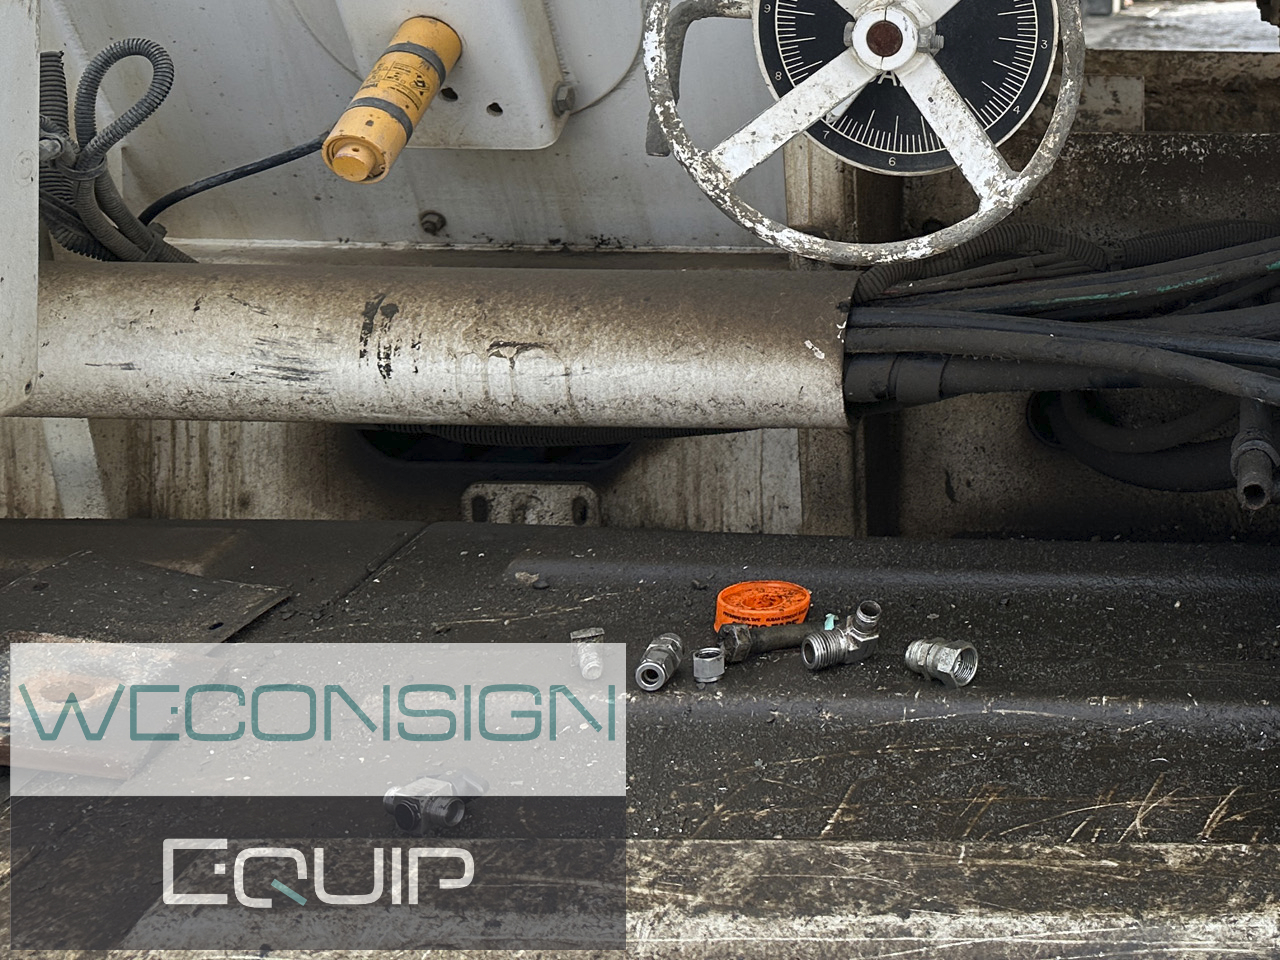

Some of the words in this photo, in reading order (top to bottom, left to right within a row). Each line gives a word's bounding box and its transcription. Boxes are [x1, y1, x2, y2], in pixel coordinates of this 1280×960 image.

[763, 4, 771, 14] 9
[1040, 39, 1048, 49] 3
[774, 71, 783, 81] 8
[1013, 105, 1021, 115] 4
[822, 130, 830, 140] 7
[888, 157, 896, 167] 6
